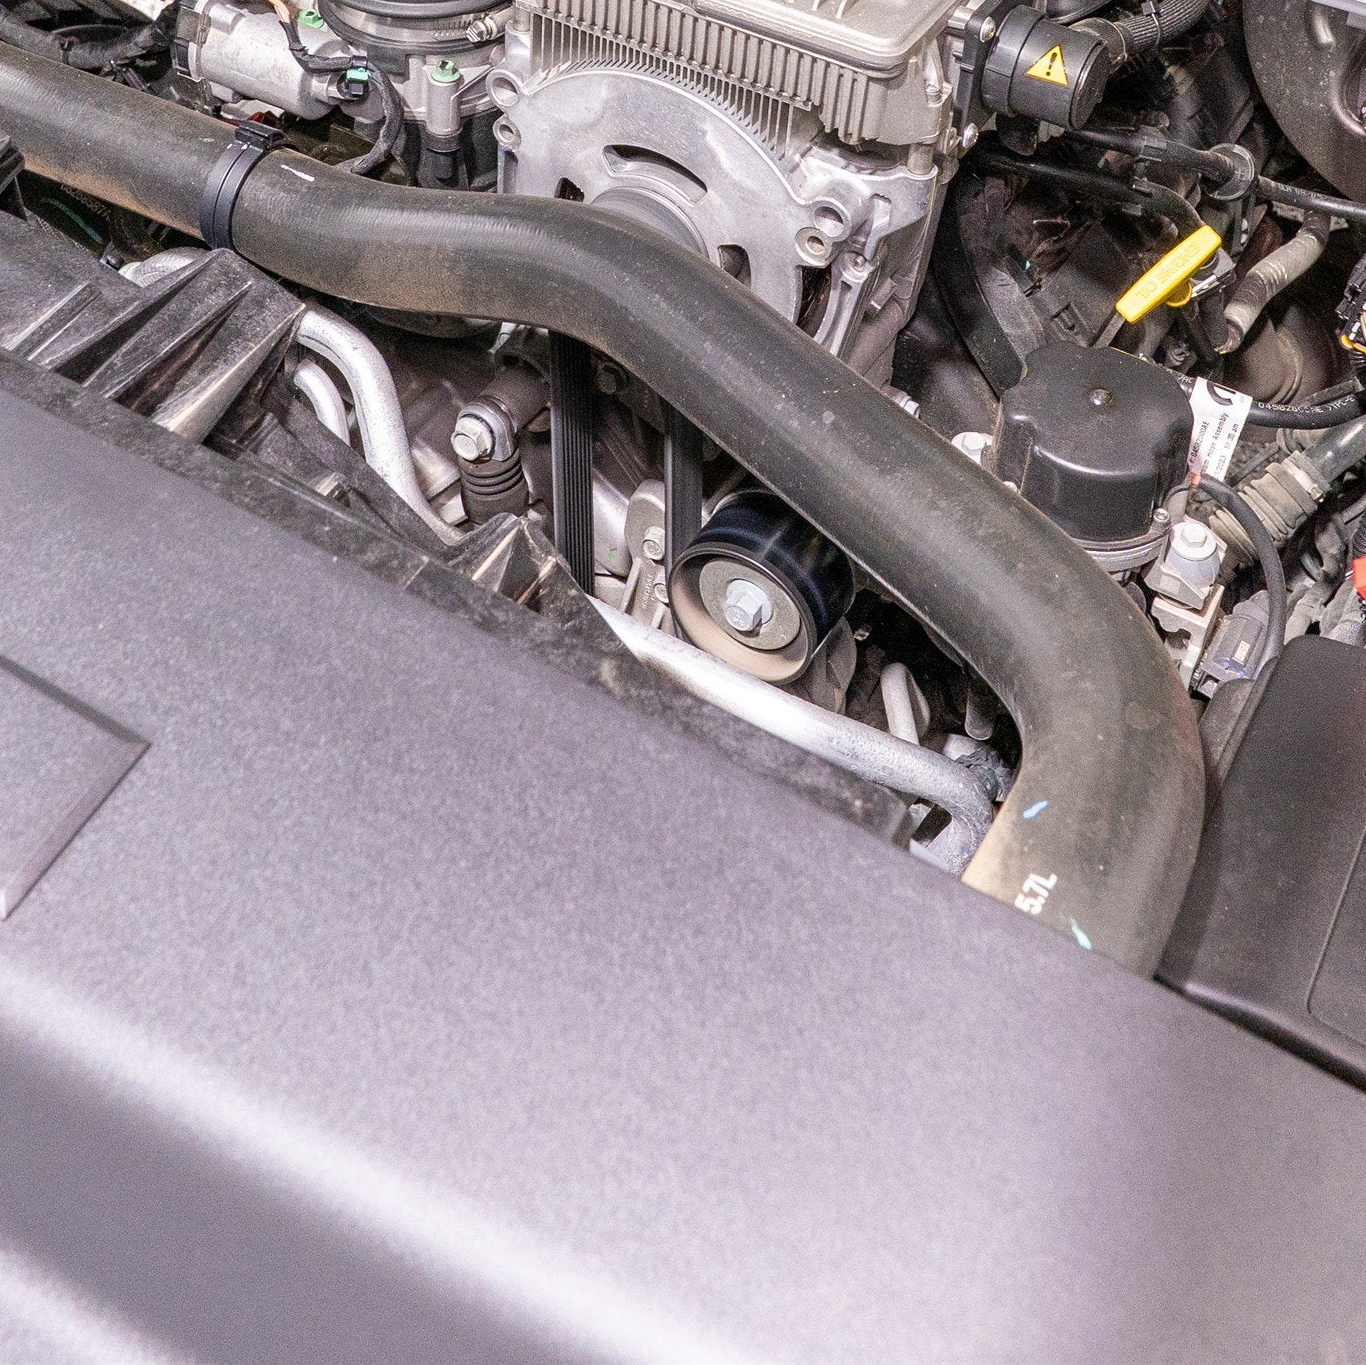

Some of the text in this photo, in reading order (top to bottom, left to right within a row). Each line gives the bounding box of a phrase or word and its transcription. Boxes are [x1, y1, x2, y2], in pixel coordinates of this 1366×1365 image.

[1135, 243, 1201, 299] ENGINE OIL
[1212, 412, 1230, 440] Assembly
